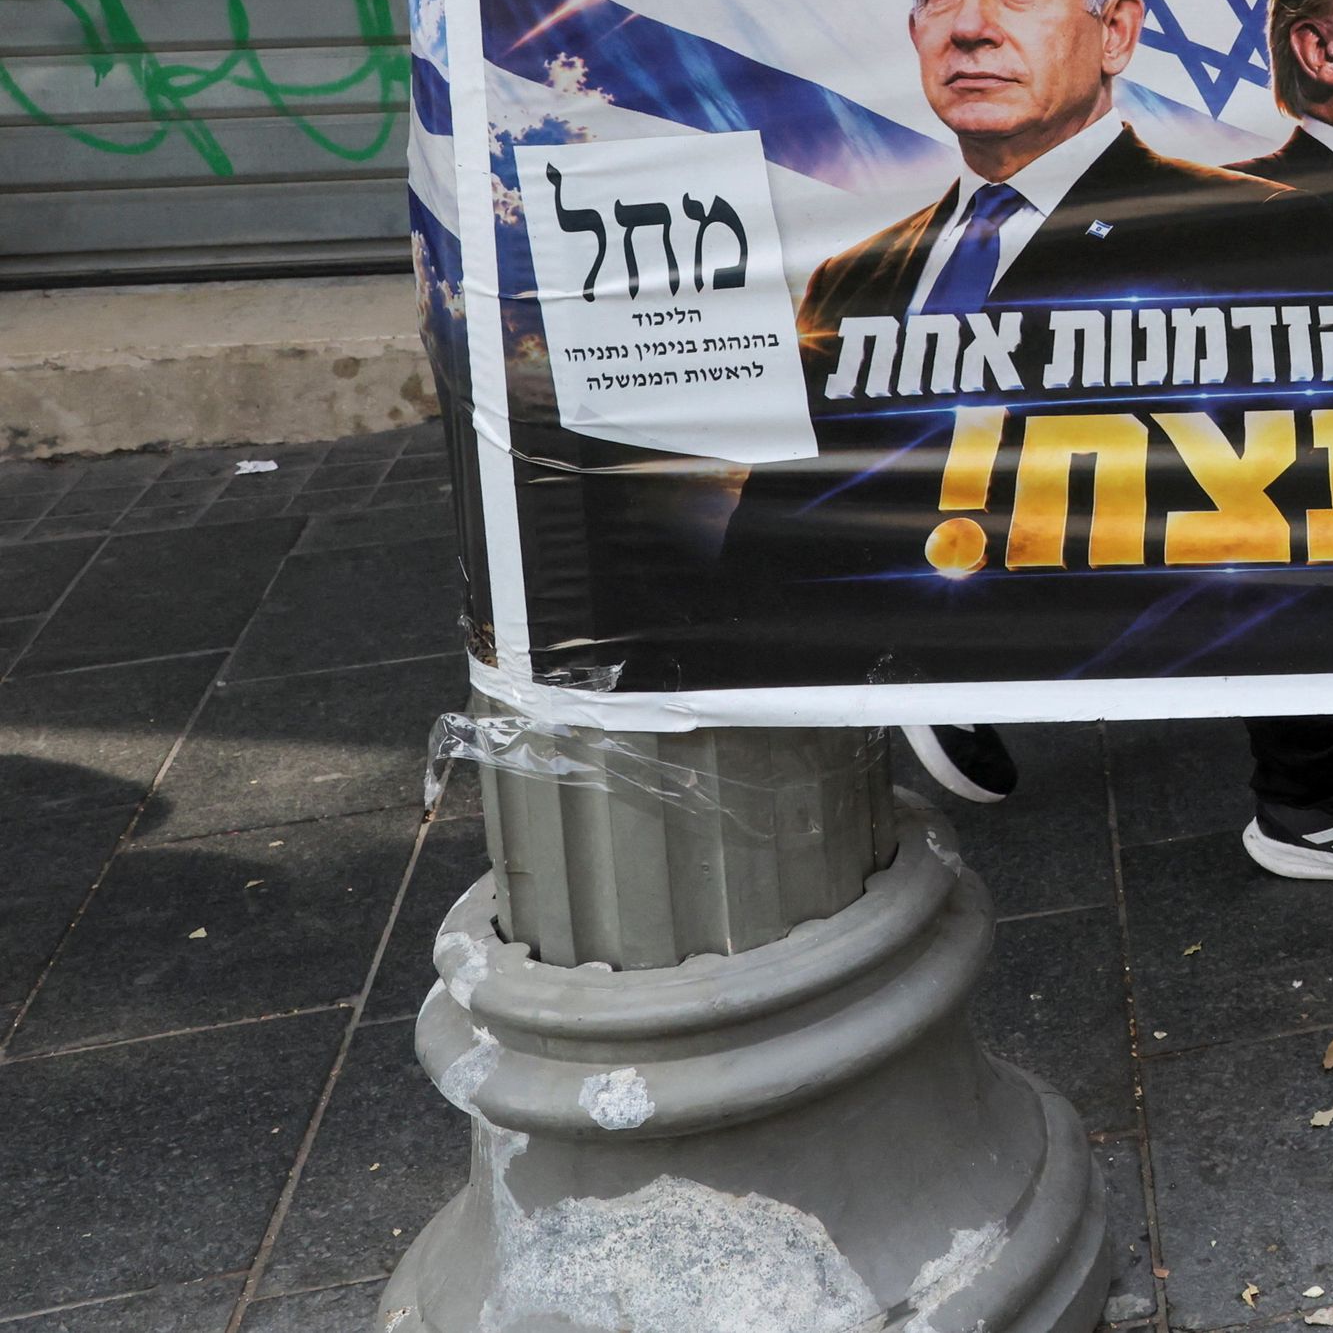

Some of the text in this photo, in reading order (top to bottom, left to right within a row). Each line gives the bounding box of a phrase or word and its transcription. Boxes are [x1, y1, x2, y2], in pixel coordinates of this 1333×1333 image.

[546, 161, 749, 303] מחל
[631, 307, 702, 328] הליכוד
[564, 331, 780, 363] בהנהגת בנימין נתניהו
[824, 310, 1028, 400] אחת
[586, 362, 765, 392] לראשות הממשלה
